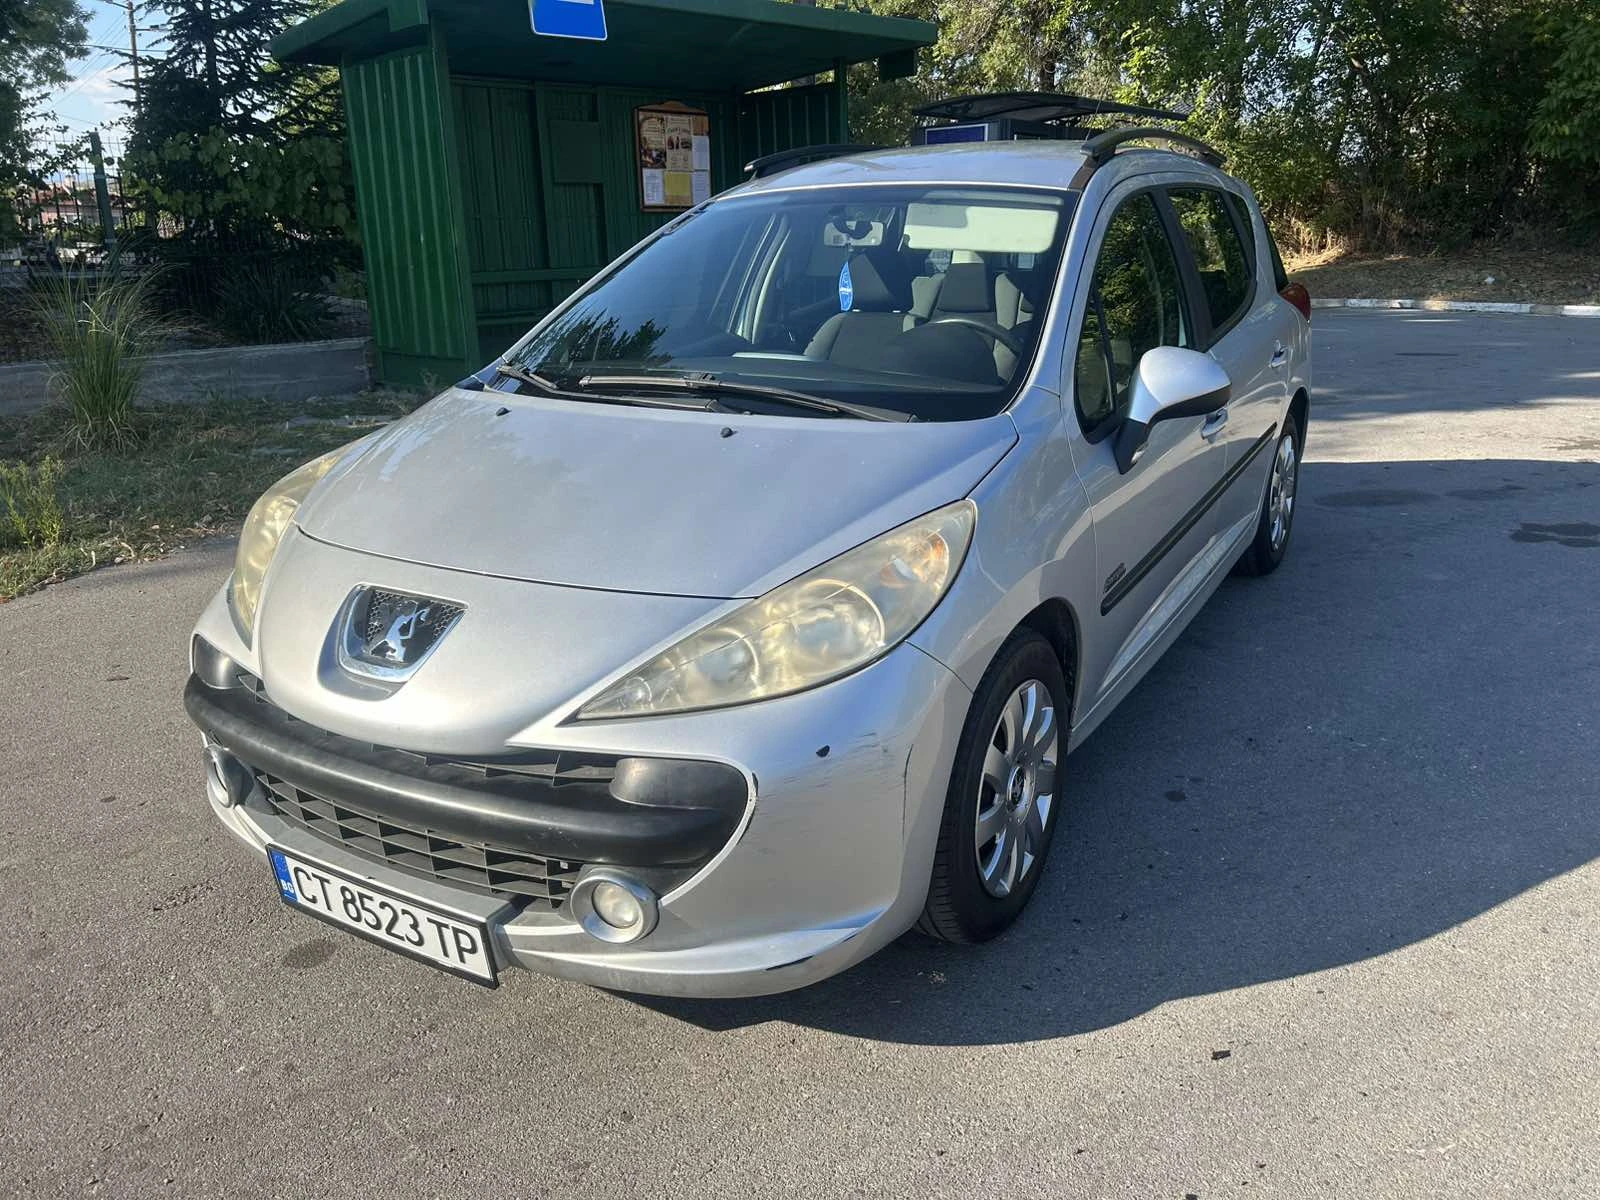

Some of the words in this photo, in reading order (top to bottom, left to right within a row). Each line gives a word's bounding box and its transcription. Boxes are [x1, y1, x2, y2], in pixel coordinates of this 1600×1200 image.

[281, 879, 294, 893] BG
[294, 866, 332, 911] CT
[340, 885, 425, 947] 8523
[426, 917, 478, 964] TP
